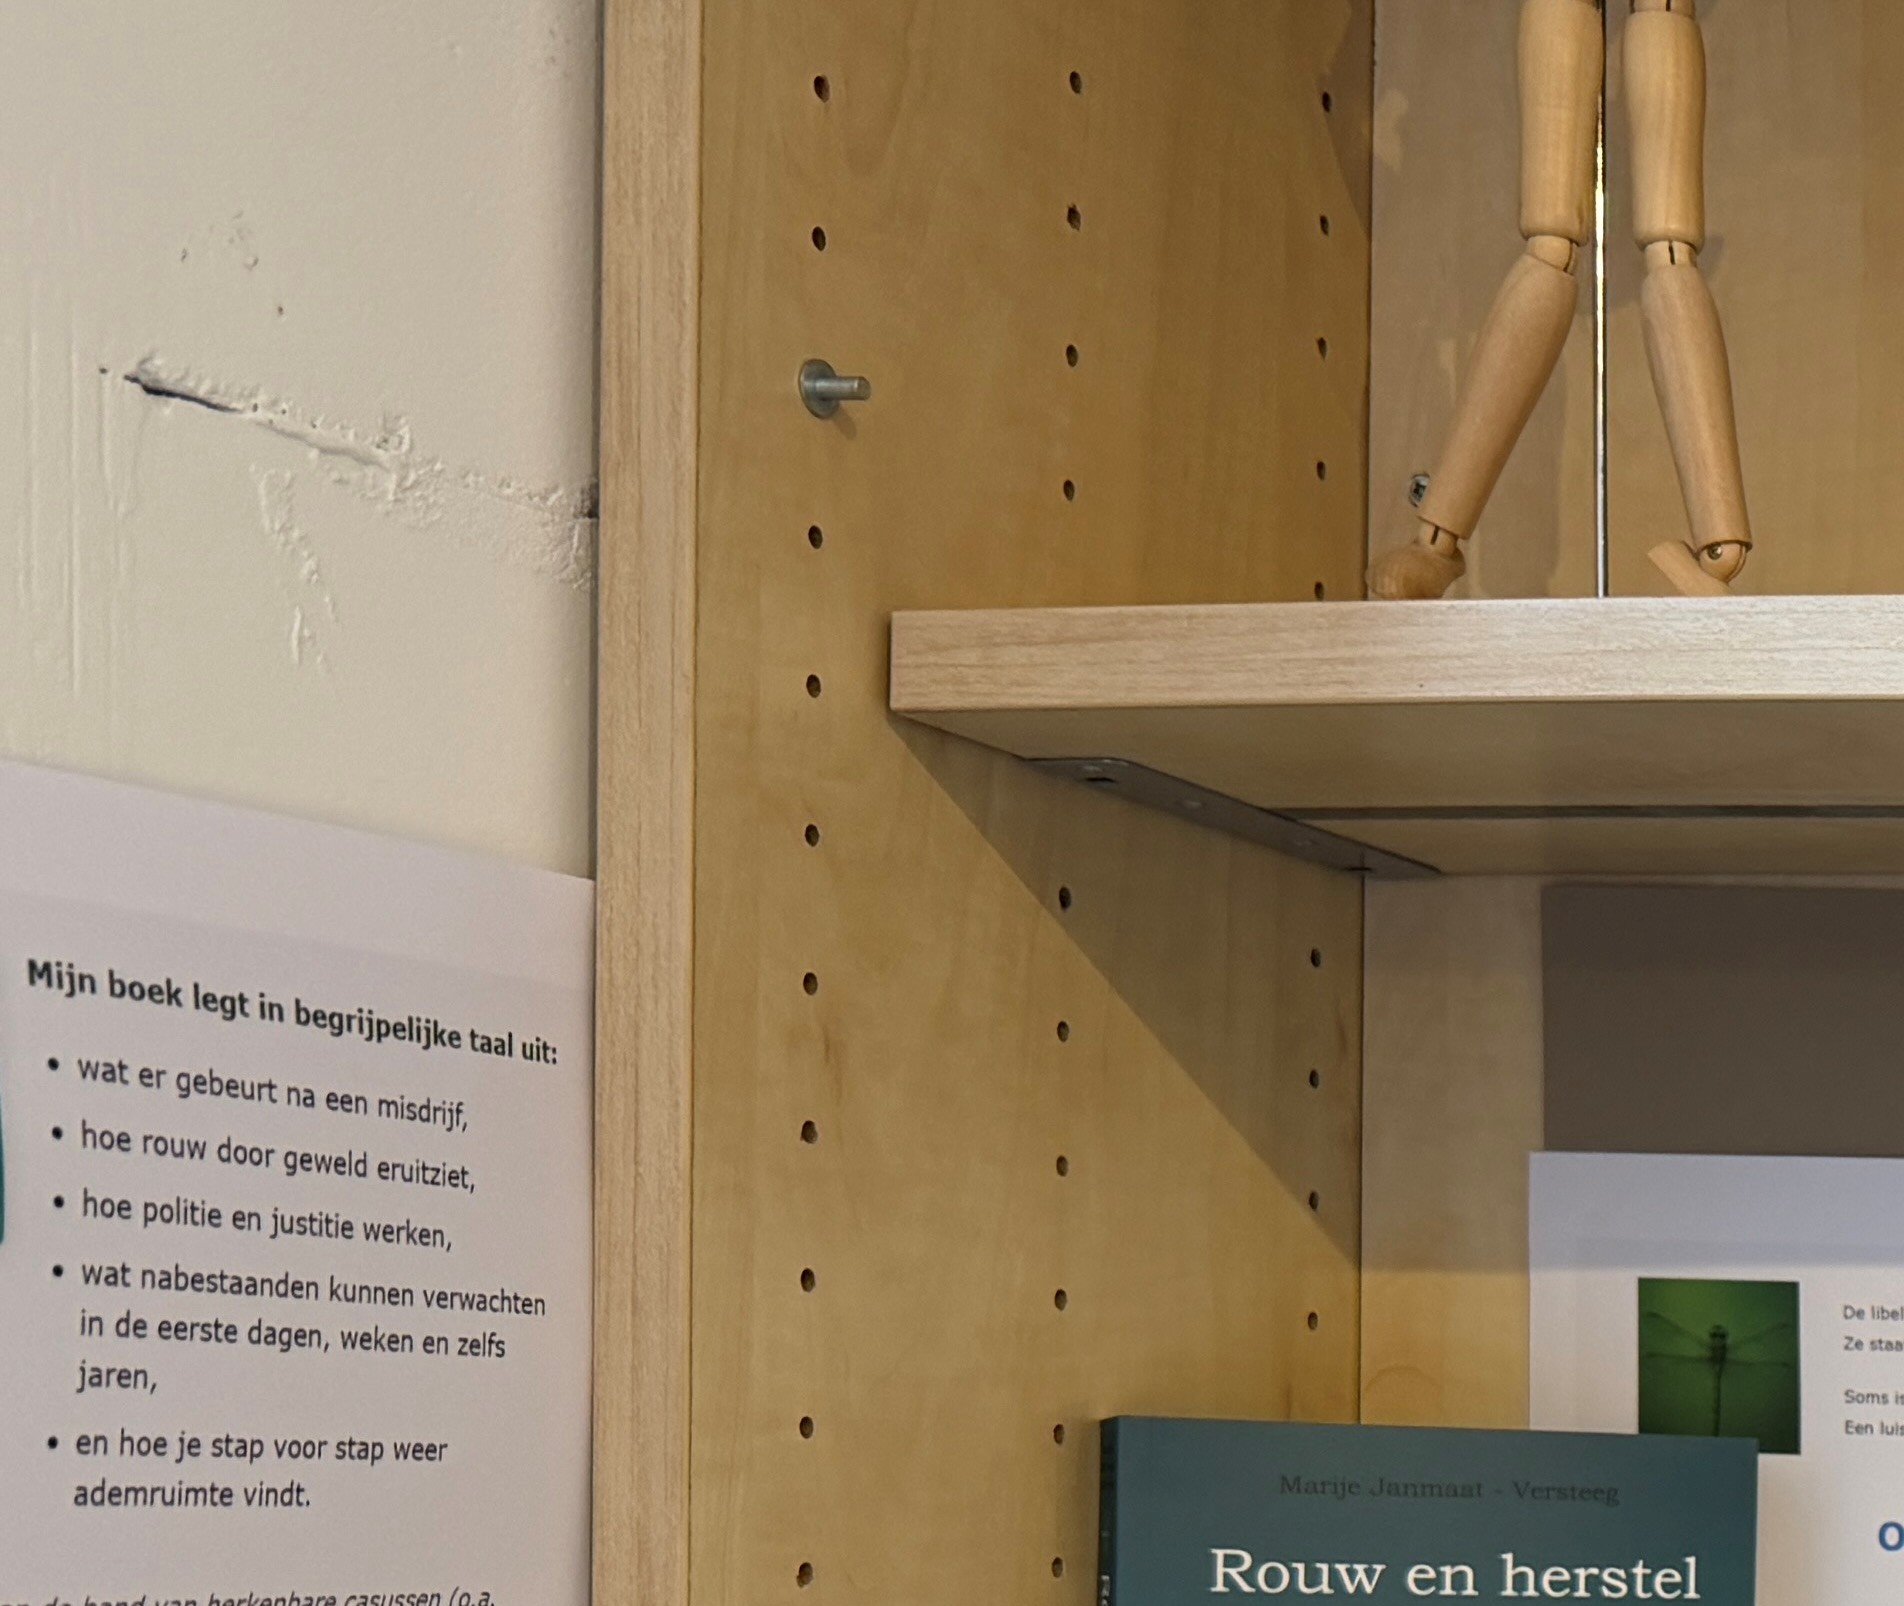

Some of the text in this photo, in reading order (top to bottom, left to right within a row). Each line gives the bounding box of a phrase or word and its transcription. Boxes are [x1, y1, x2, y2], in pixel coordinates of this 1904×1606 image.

[28, 959, 557, 1065] Mijn boek legt in begrijpelijke taal uit:
[78, 1059, 467, 1132] wat er gebeurt na een misdrijf,
[82, 1120, 474, 1194] hoe rouw door geweld eruitziet,
[83, 1188, 451, 1252] hoe politie en justitie werken,
[82, 1262, 545, 1316] wat nabestaanden kunnen verwachten
[1842, 1304, 1866, 1321] De
[81, 1309, 505, 1358] in de eerste dagen, weken en zelfs
[76, 1359, 156, 1395] jaren,
[1279, 1474, 1620, 1507] Marije Janmaat Versteeg
[1211, 1549, 1700, 1599] Rouw en herstel
